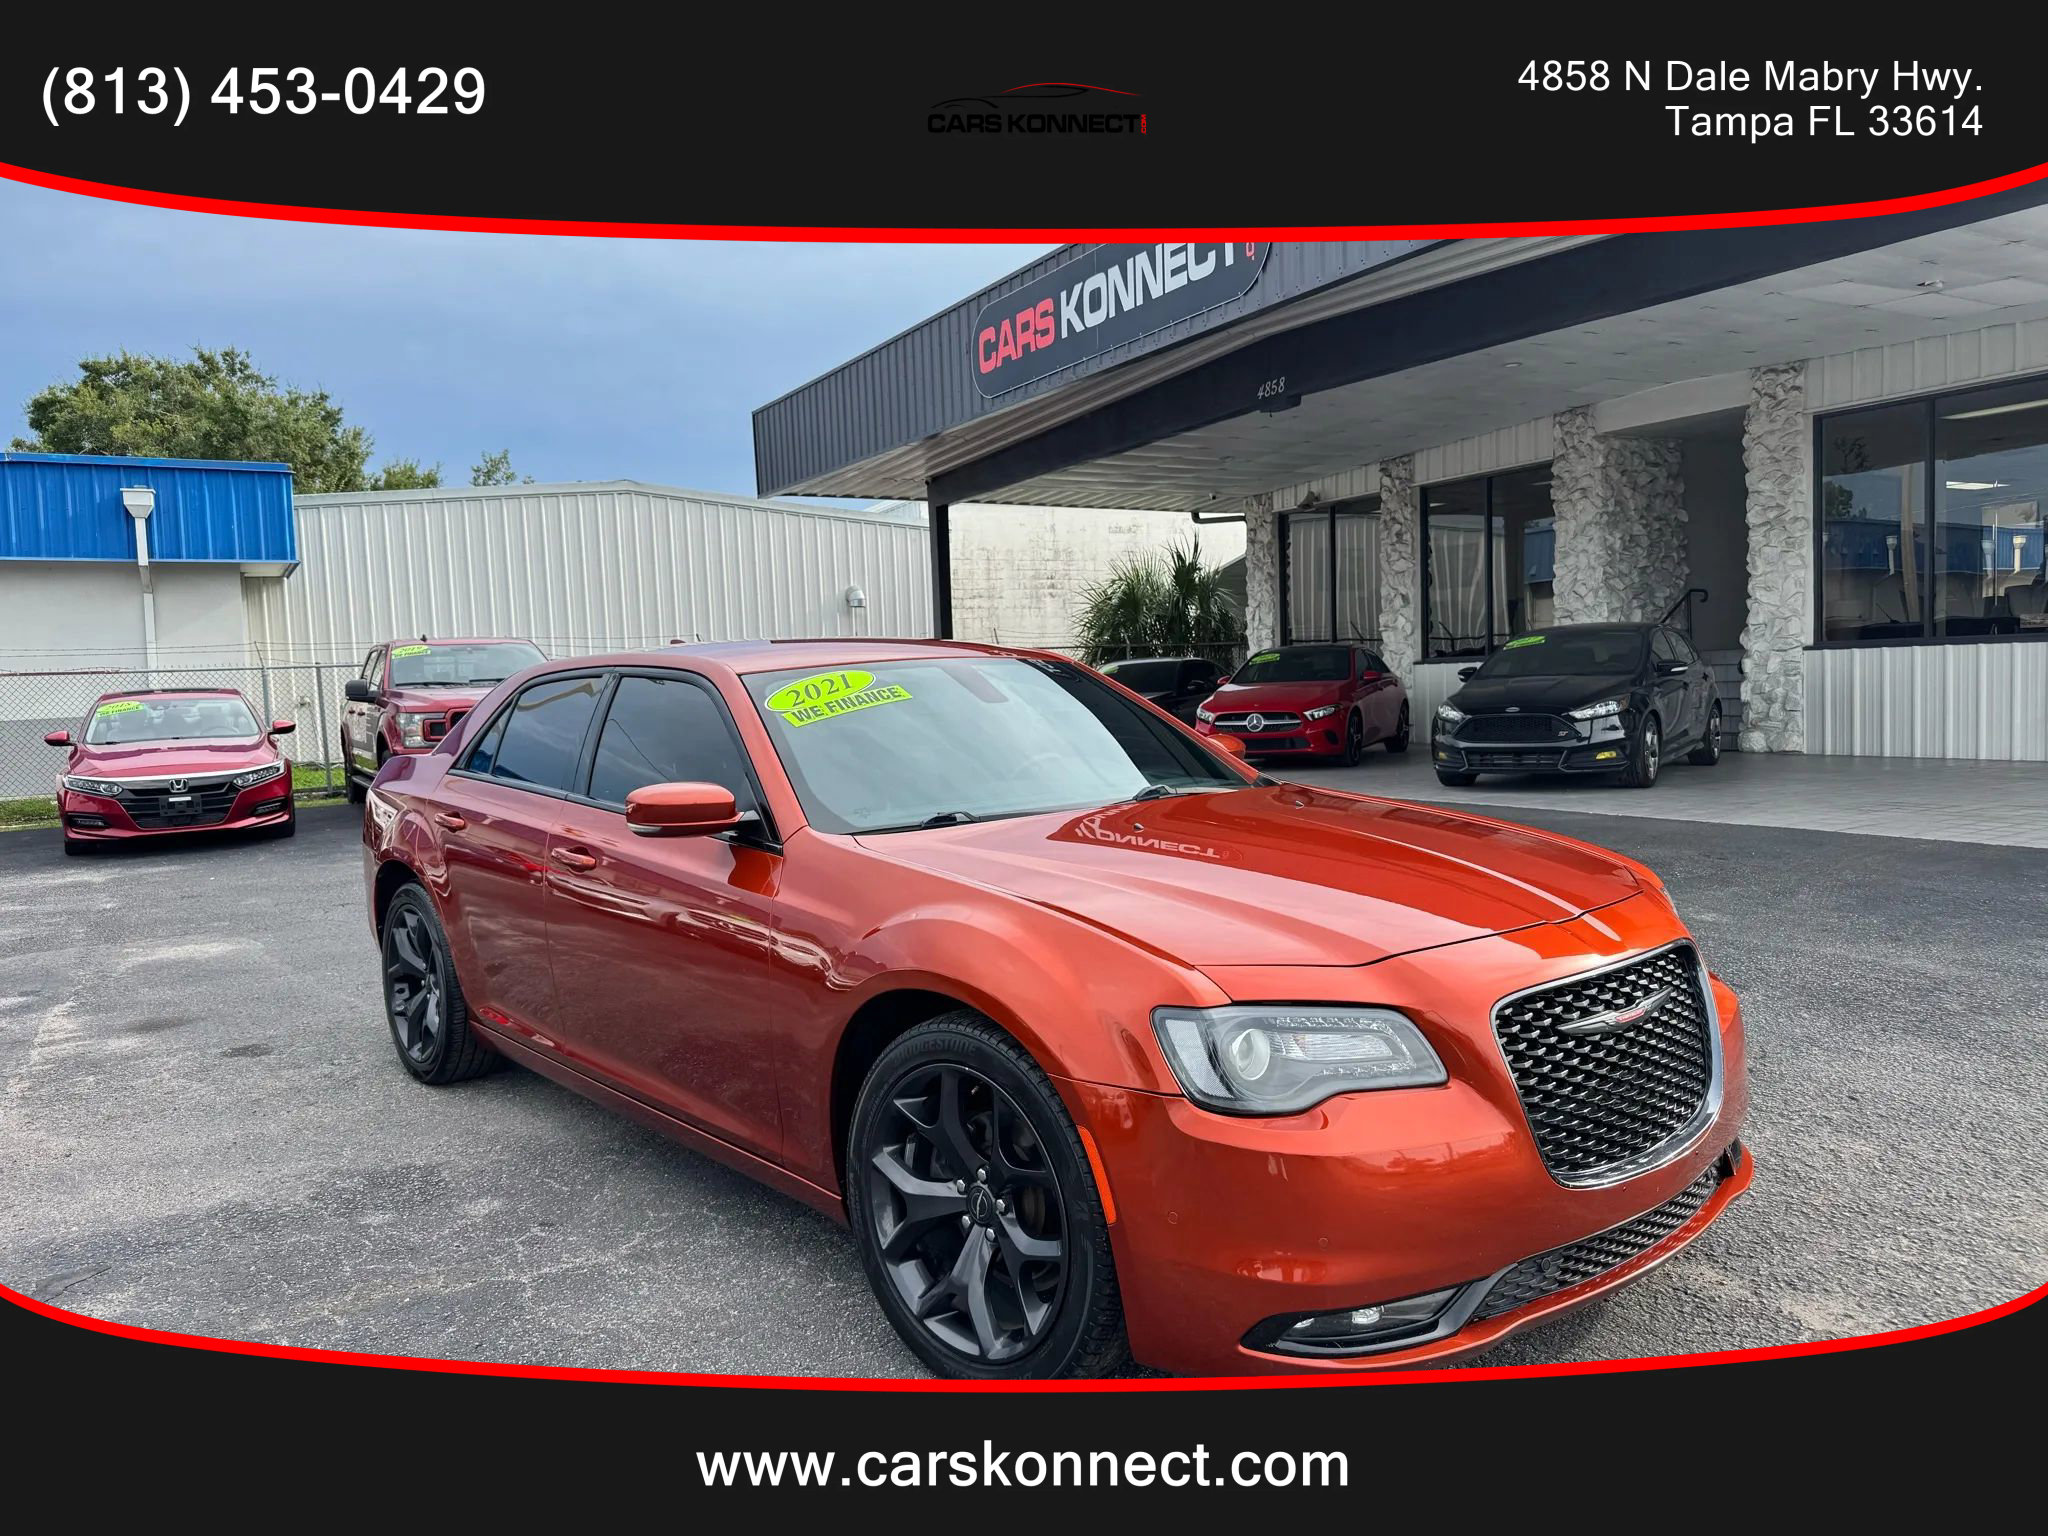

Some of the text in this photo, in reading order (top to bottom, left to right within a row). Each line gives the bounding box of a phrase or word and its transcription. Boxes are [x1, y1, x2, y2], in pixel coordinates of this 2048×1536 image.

[978, 297, 1056, 375] CARS
[1256, 375, 1286, 400] 4858
[786, 672, 852, 708] 2021
[791, 686, 902, 723] WE FINANCE
